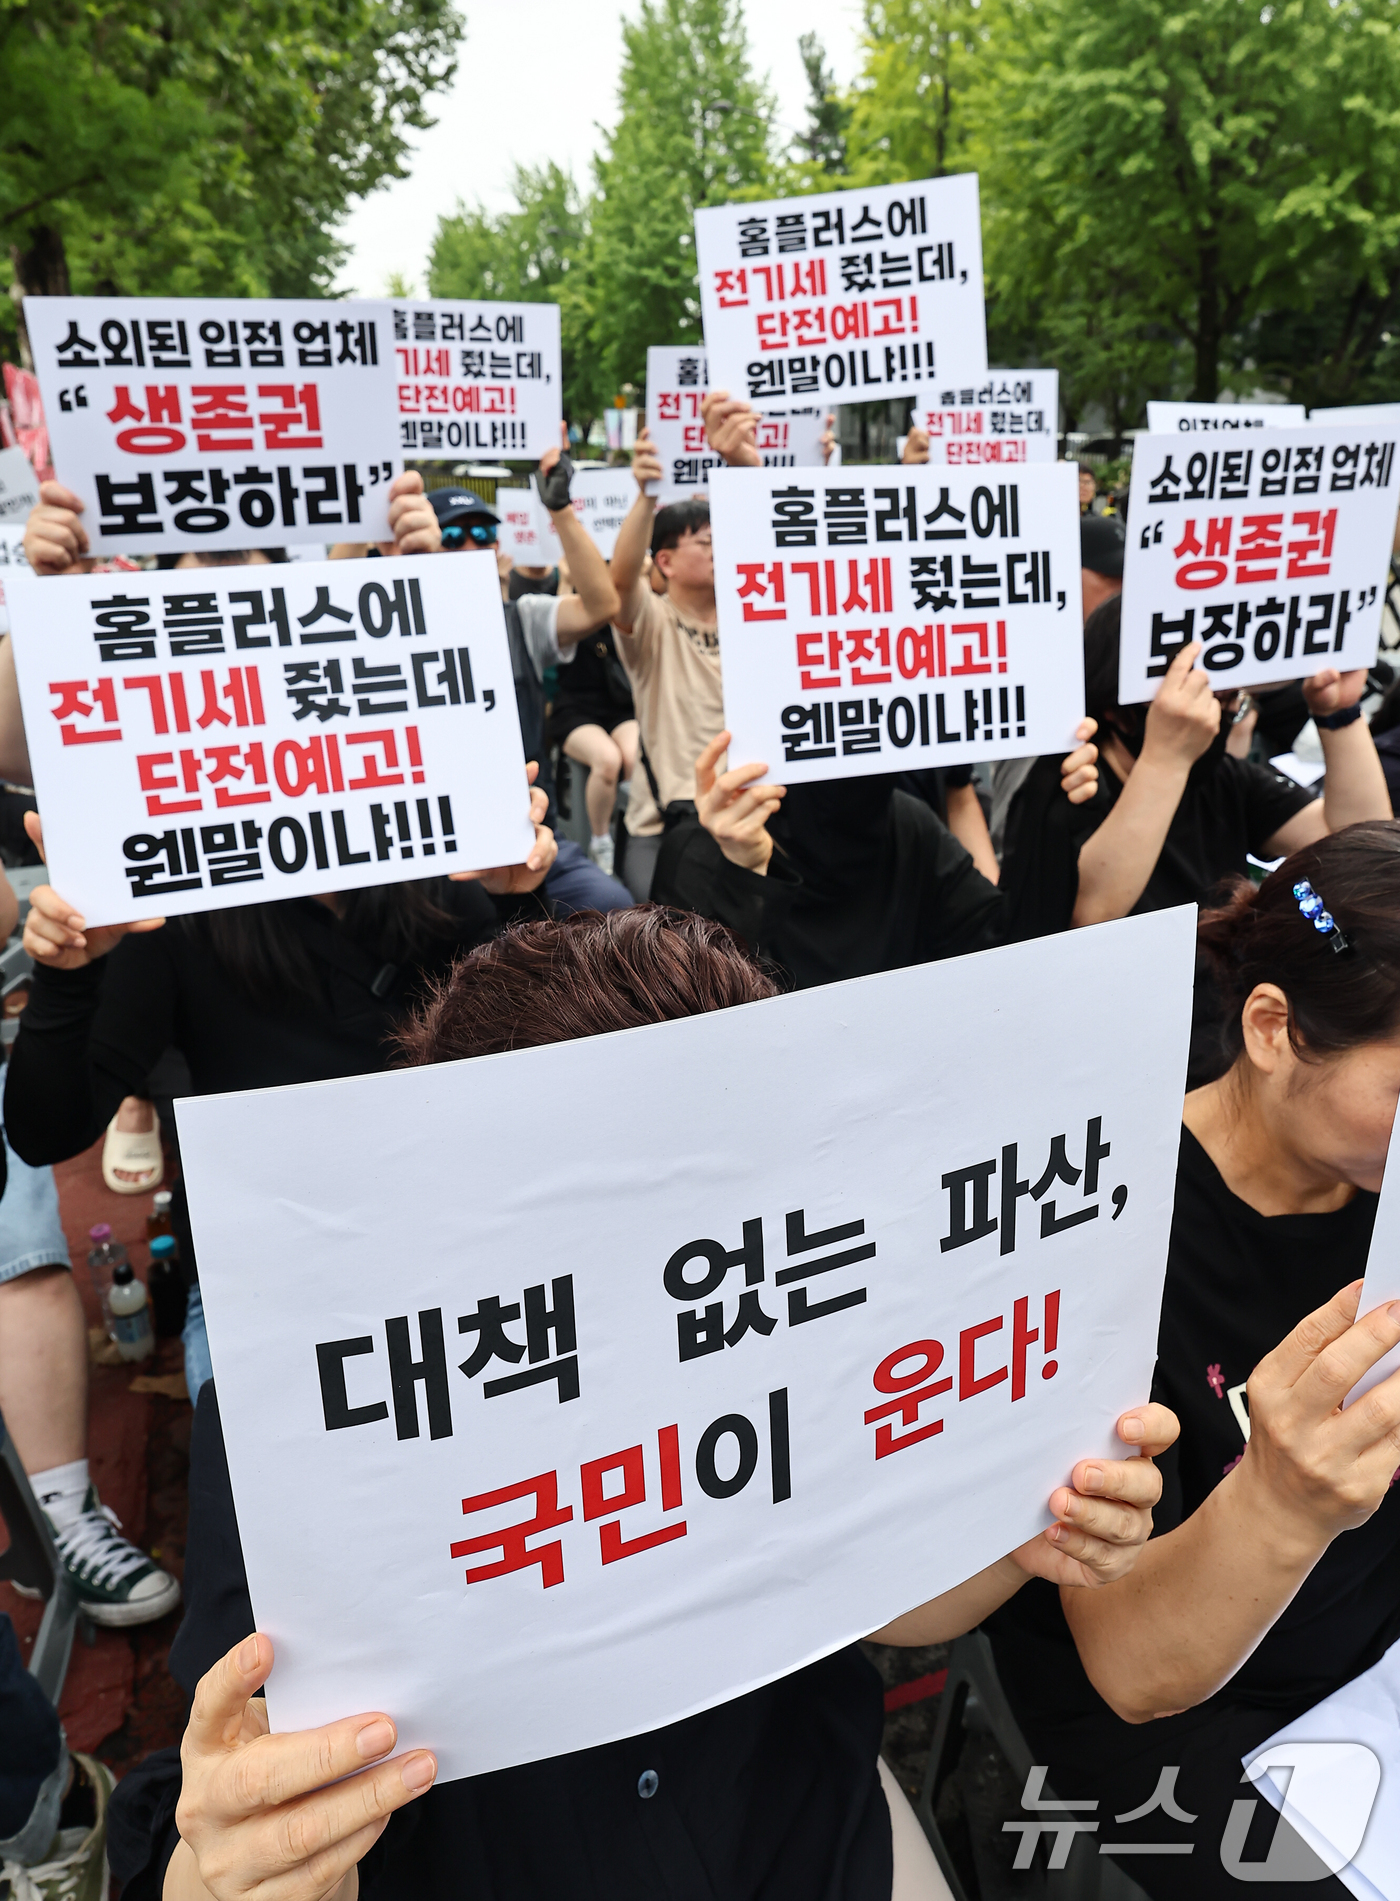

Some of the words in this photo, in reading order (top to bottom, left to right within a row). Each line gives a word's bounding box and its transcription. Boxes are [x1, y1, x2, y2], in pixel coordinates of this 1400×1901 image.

[738, 197, 926, 257] 홈플러스에
[714, 258, 827, 308] 전기세
[841, 242, 967, 292] 줬는데,
[56, 320, 191, 368] 소외된
[199, 321, 284, 367] 입점
[293, 320, 378, 367] 업체
[757, 295, 918, 350] 단전예고!
[396, 348, 450, 376] 기세
[462, 351, 550, 382] 줬는데,
[747, 342, 934, 398] 웬말이냐!!!
[398, 385, 515, 413] 단전예고!
[928, 412, 982, 436] 전기세
[947, 441, 1024, 464] 단전예고!
[1149, 450, 1253, 503] 소외된
[1260, 446, 1324, 497] 입점
[1330, 442, 1395, 492] 업체
[772, 485, 1019, 547] 홈플러스에
[736, 557, 893, 622] 전기세
[910, 551, 1066, 612] 줬는데,
[91, 578, 426, 662] 홈플러스에
[796, 620, 1007, 689] 단전예고!
[49, 665, 265, 745] 전기세
[284, 648, 495, 722] 줬는데,
[781, 686, 1025, 762] 웬말이냐!!!
[137, 726, 425, 816] 단전예고!
[123, 795, 457, 898] 웬말이냐!!!
[316, 1274, 580, 1441] 대책
[663, 1209, 876, 1363] 없는
[940, 1116, 1127, 1256] 파산,
[450, 1387, 791, 1589] 국민이
[865, 1290, 1060, 1459] 운다!
